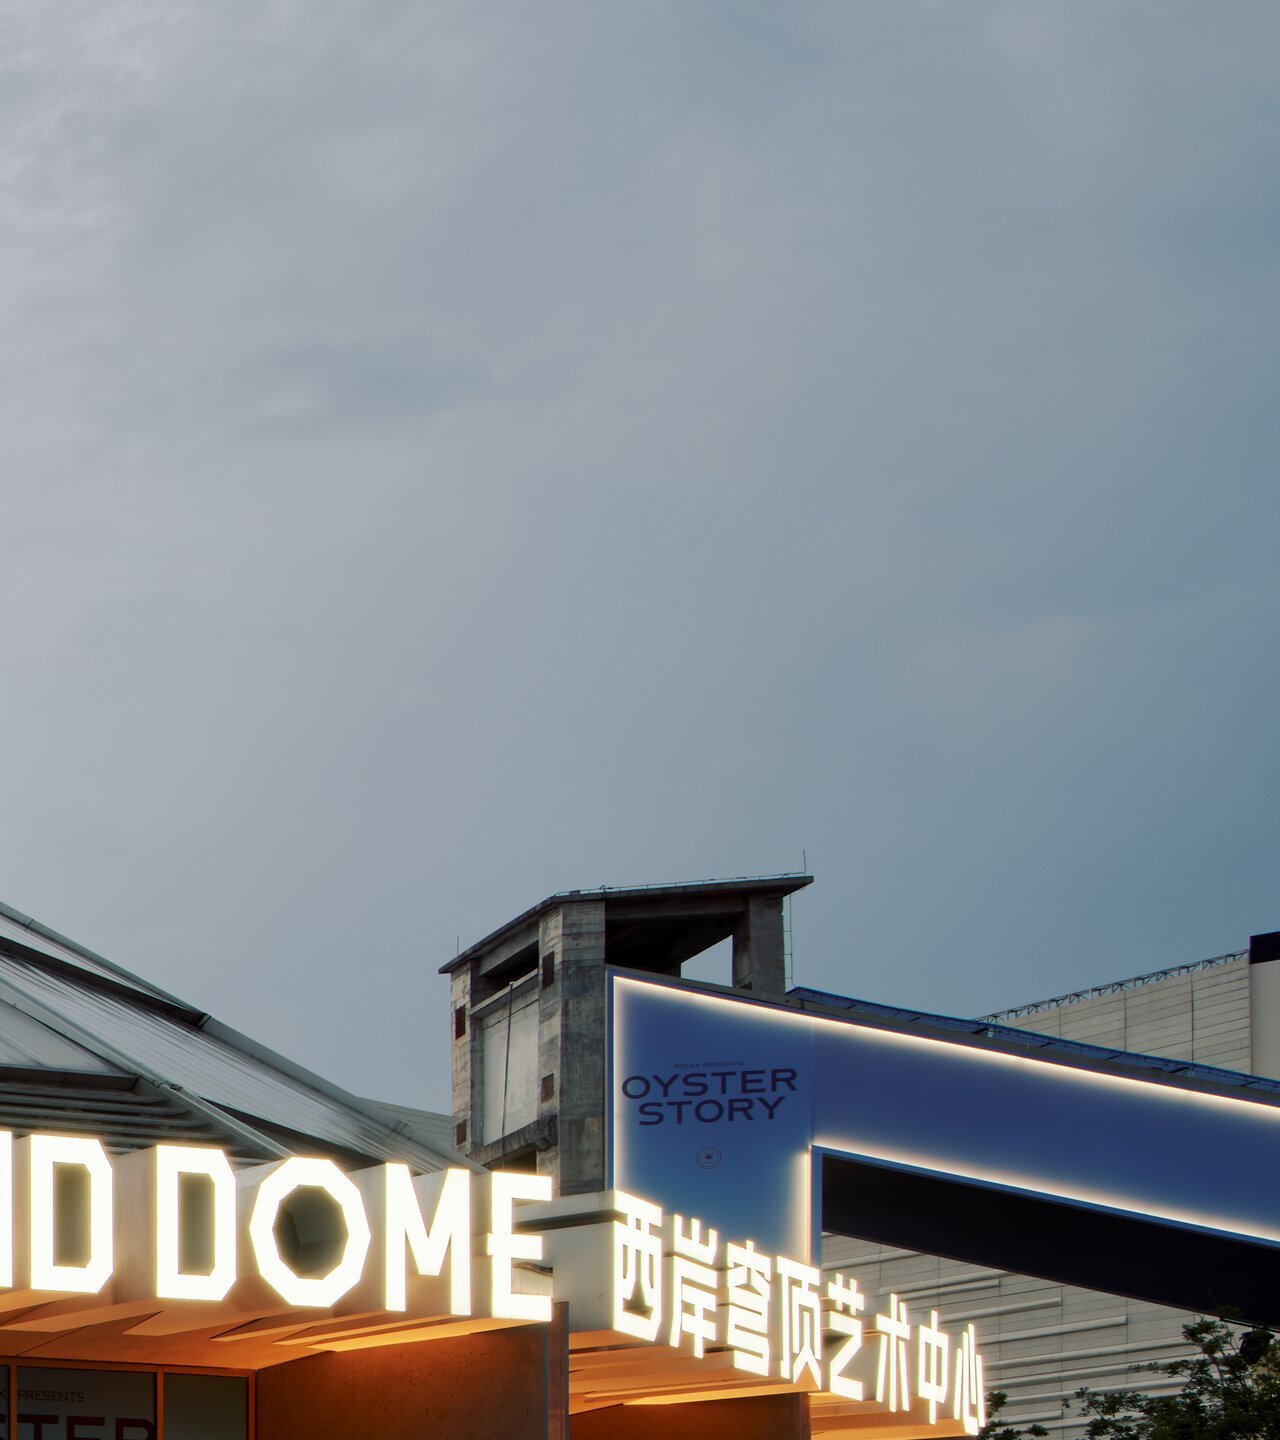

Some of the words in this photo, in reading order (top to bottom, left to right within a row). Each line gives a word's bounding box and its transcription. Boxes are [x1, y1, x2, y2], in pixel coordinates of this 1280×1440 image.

[621, 1068, 798, 1100] OYSTER
[638, 1096, 786, 1126] STORY
[155, 1143, 553, 1322] DOME
[612, 1188, 987, 1436] 西岸穹顶艺术中心
[17, 1389, 85, 1403] PRESENTS
